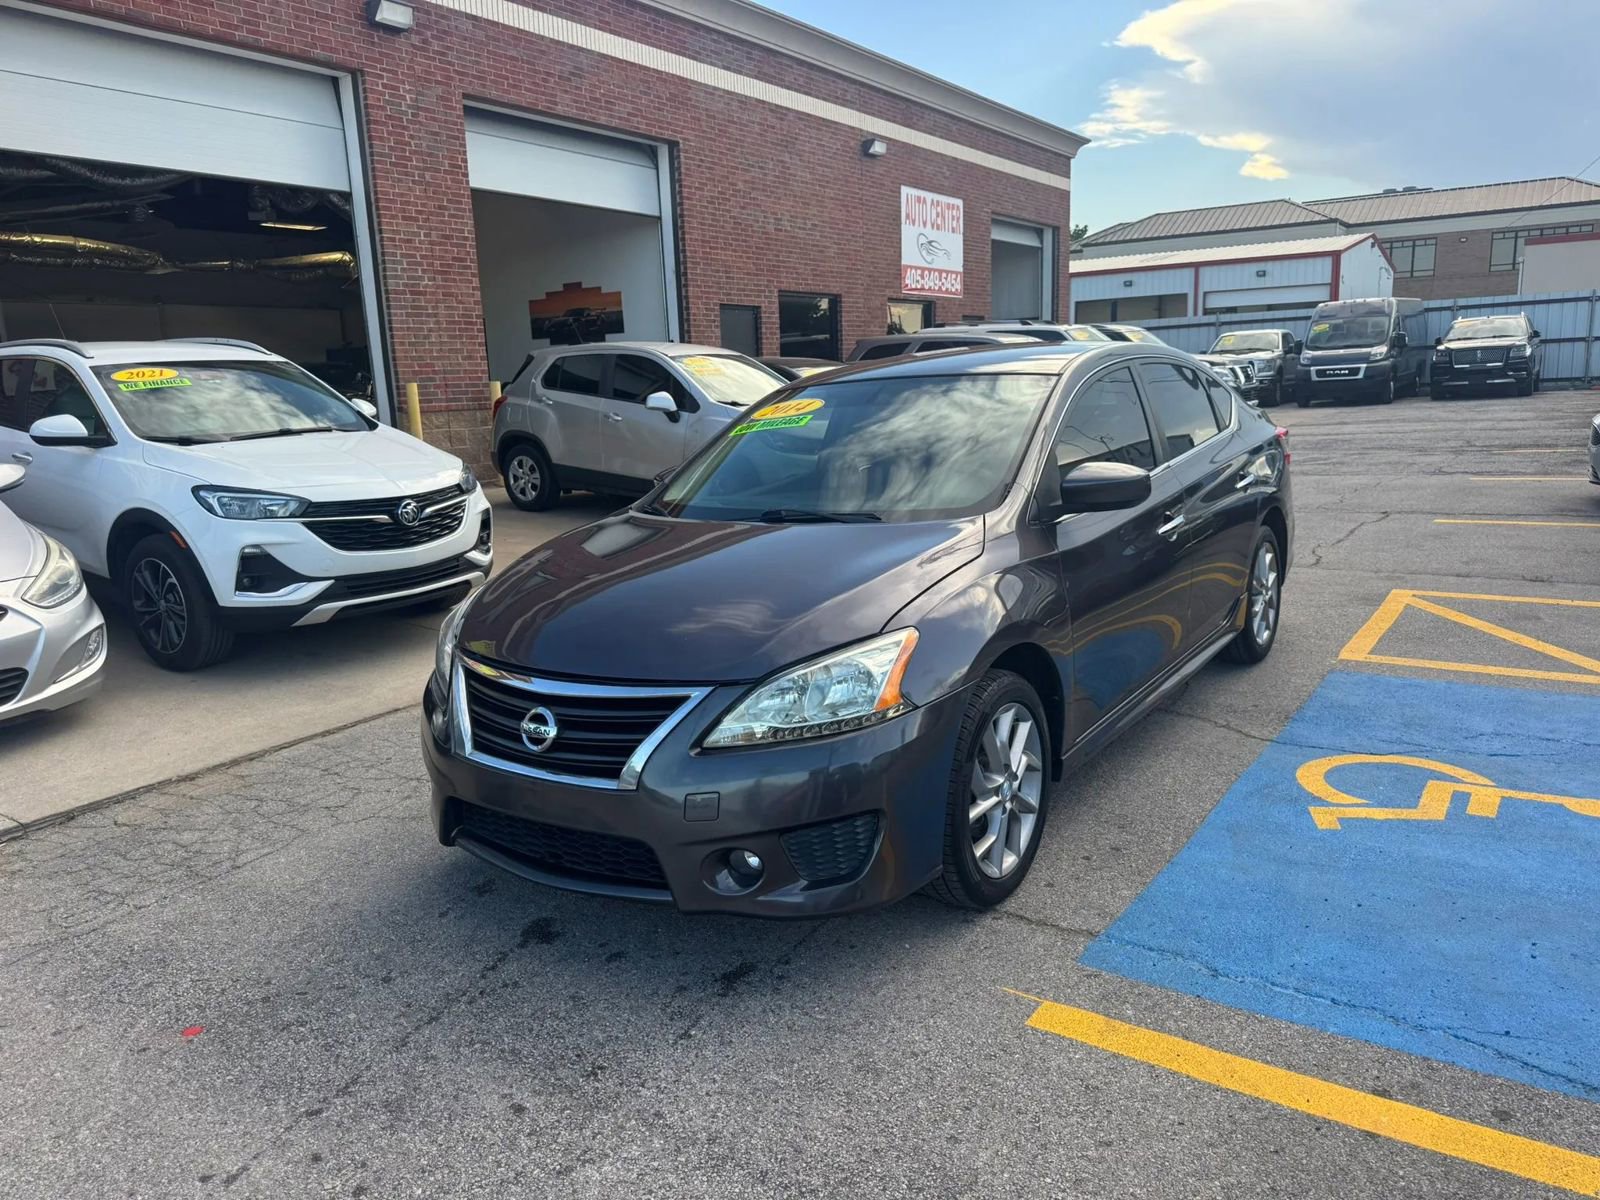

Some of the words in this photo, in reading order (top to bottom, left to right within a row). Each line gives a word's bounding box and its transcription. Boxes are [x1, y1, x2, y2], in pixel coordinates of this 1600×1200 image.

[904, 192, 928, 229] AUTO
[929, 198, 961, 235] CENTER
[904, 267, 961, 292] 405-849-5454
[127, 369, 164, 380] 2021
[123, 382, 140, 390] WE
[143, 378, 187, 388] FINANCE
[758, 400, 818, 417] 2014
[757, 416, 811, 429] MILEAGE
